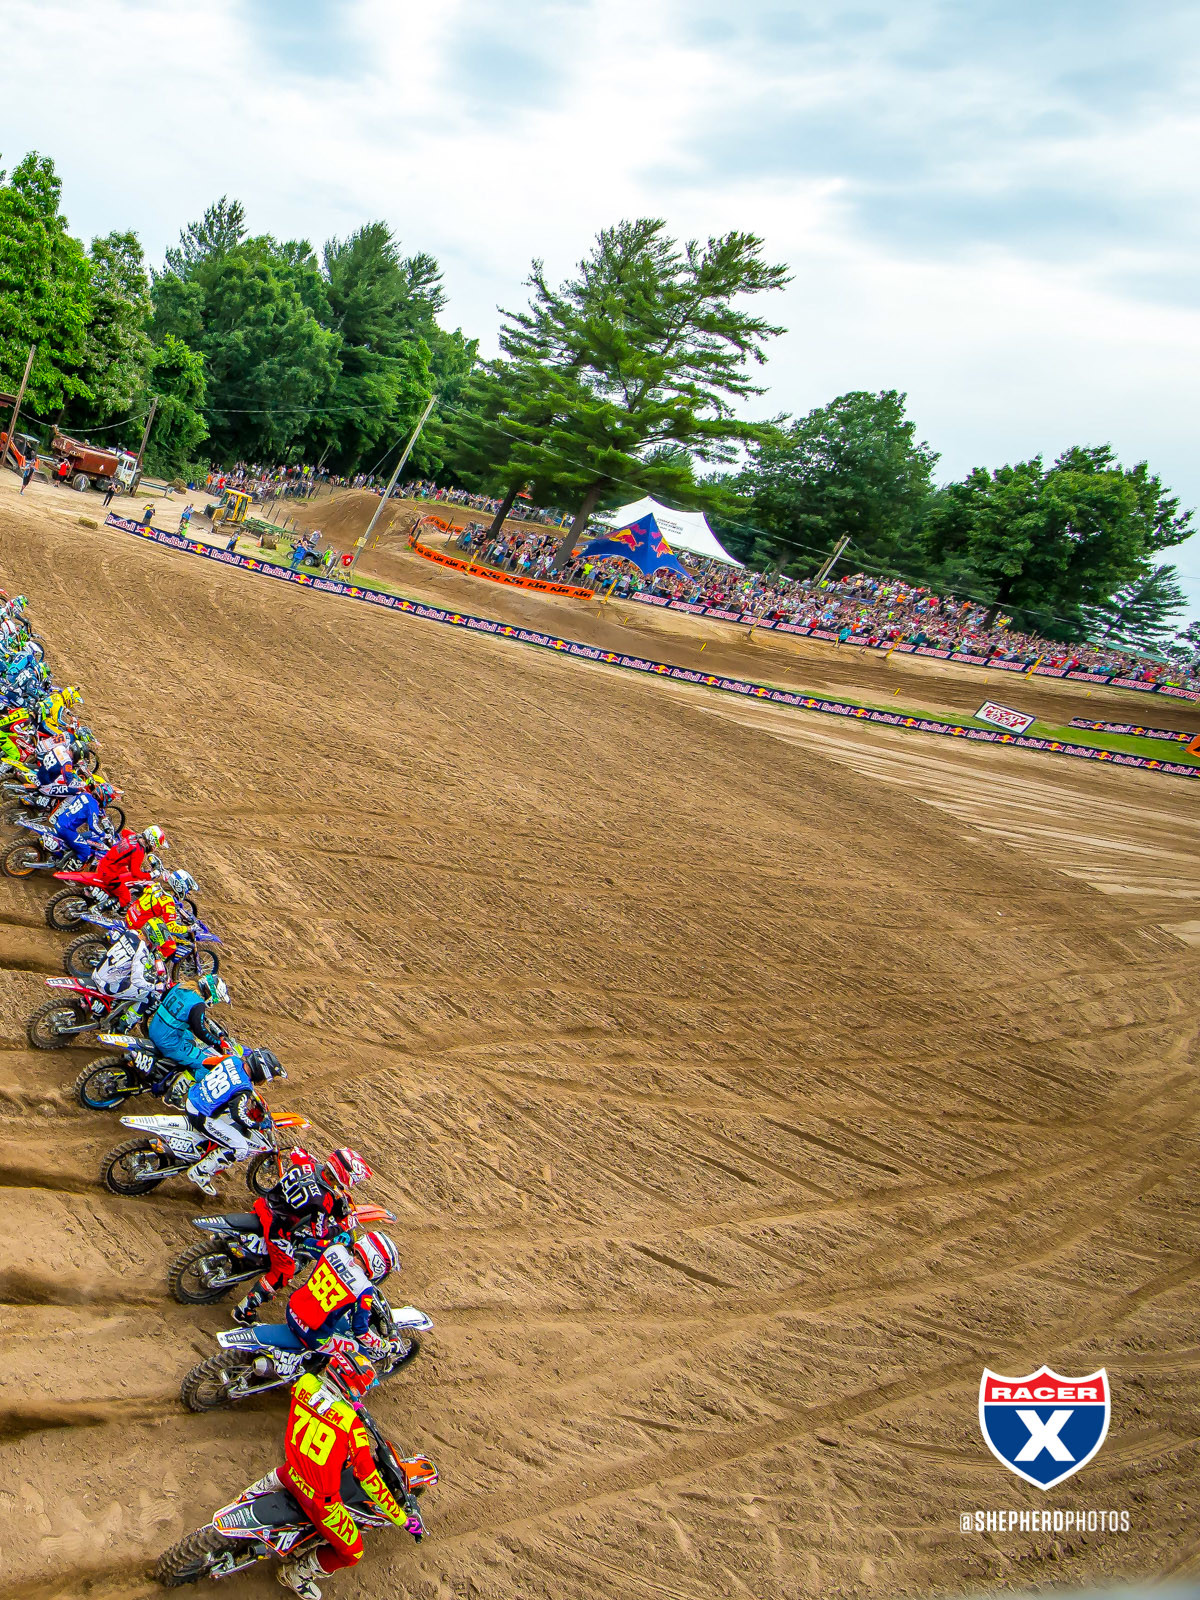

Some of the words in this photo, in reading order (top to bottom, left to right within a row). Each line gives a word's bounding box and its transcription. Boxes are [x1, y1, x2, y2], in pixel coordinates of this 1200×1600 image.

[528, 582, 547, 590] KTM
[550, 586, 570, 594] KTM
[135, 1051, 154, 1073] 483
[326, 1251, 358, 1291] RIDEL
[291, 1404, 337, 1466] 719
[277, 1530, 300, 1551] 719
